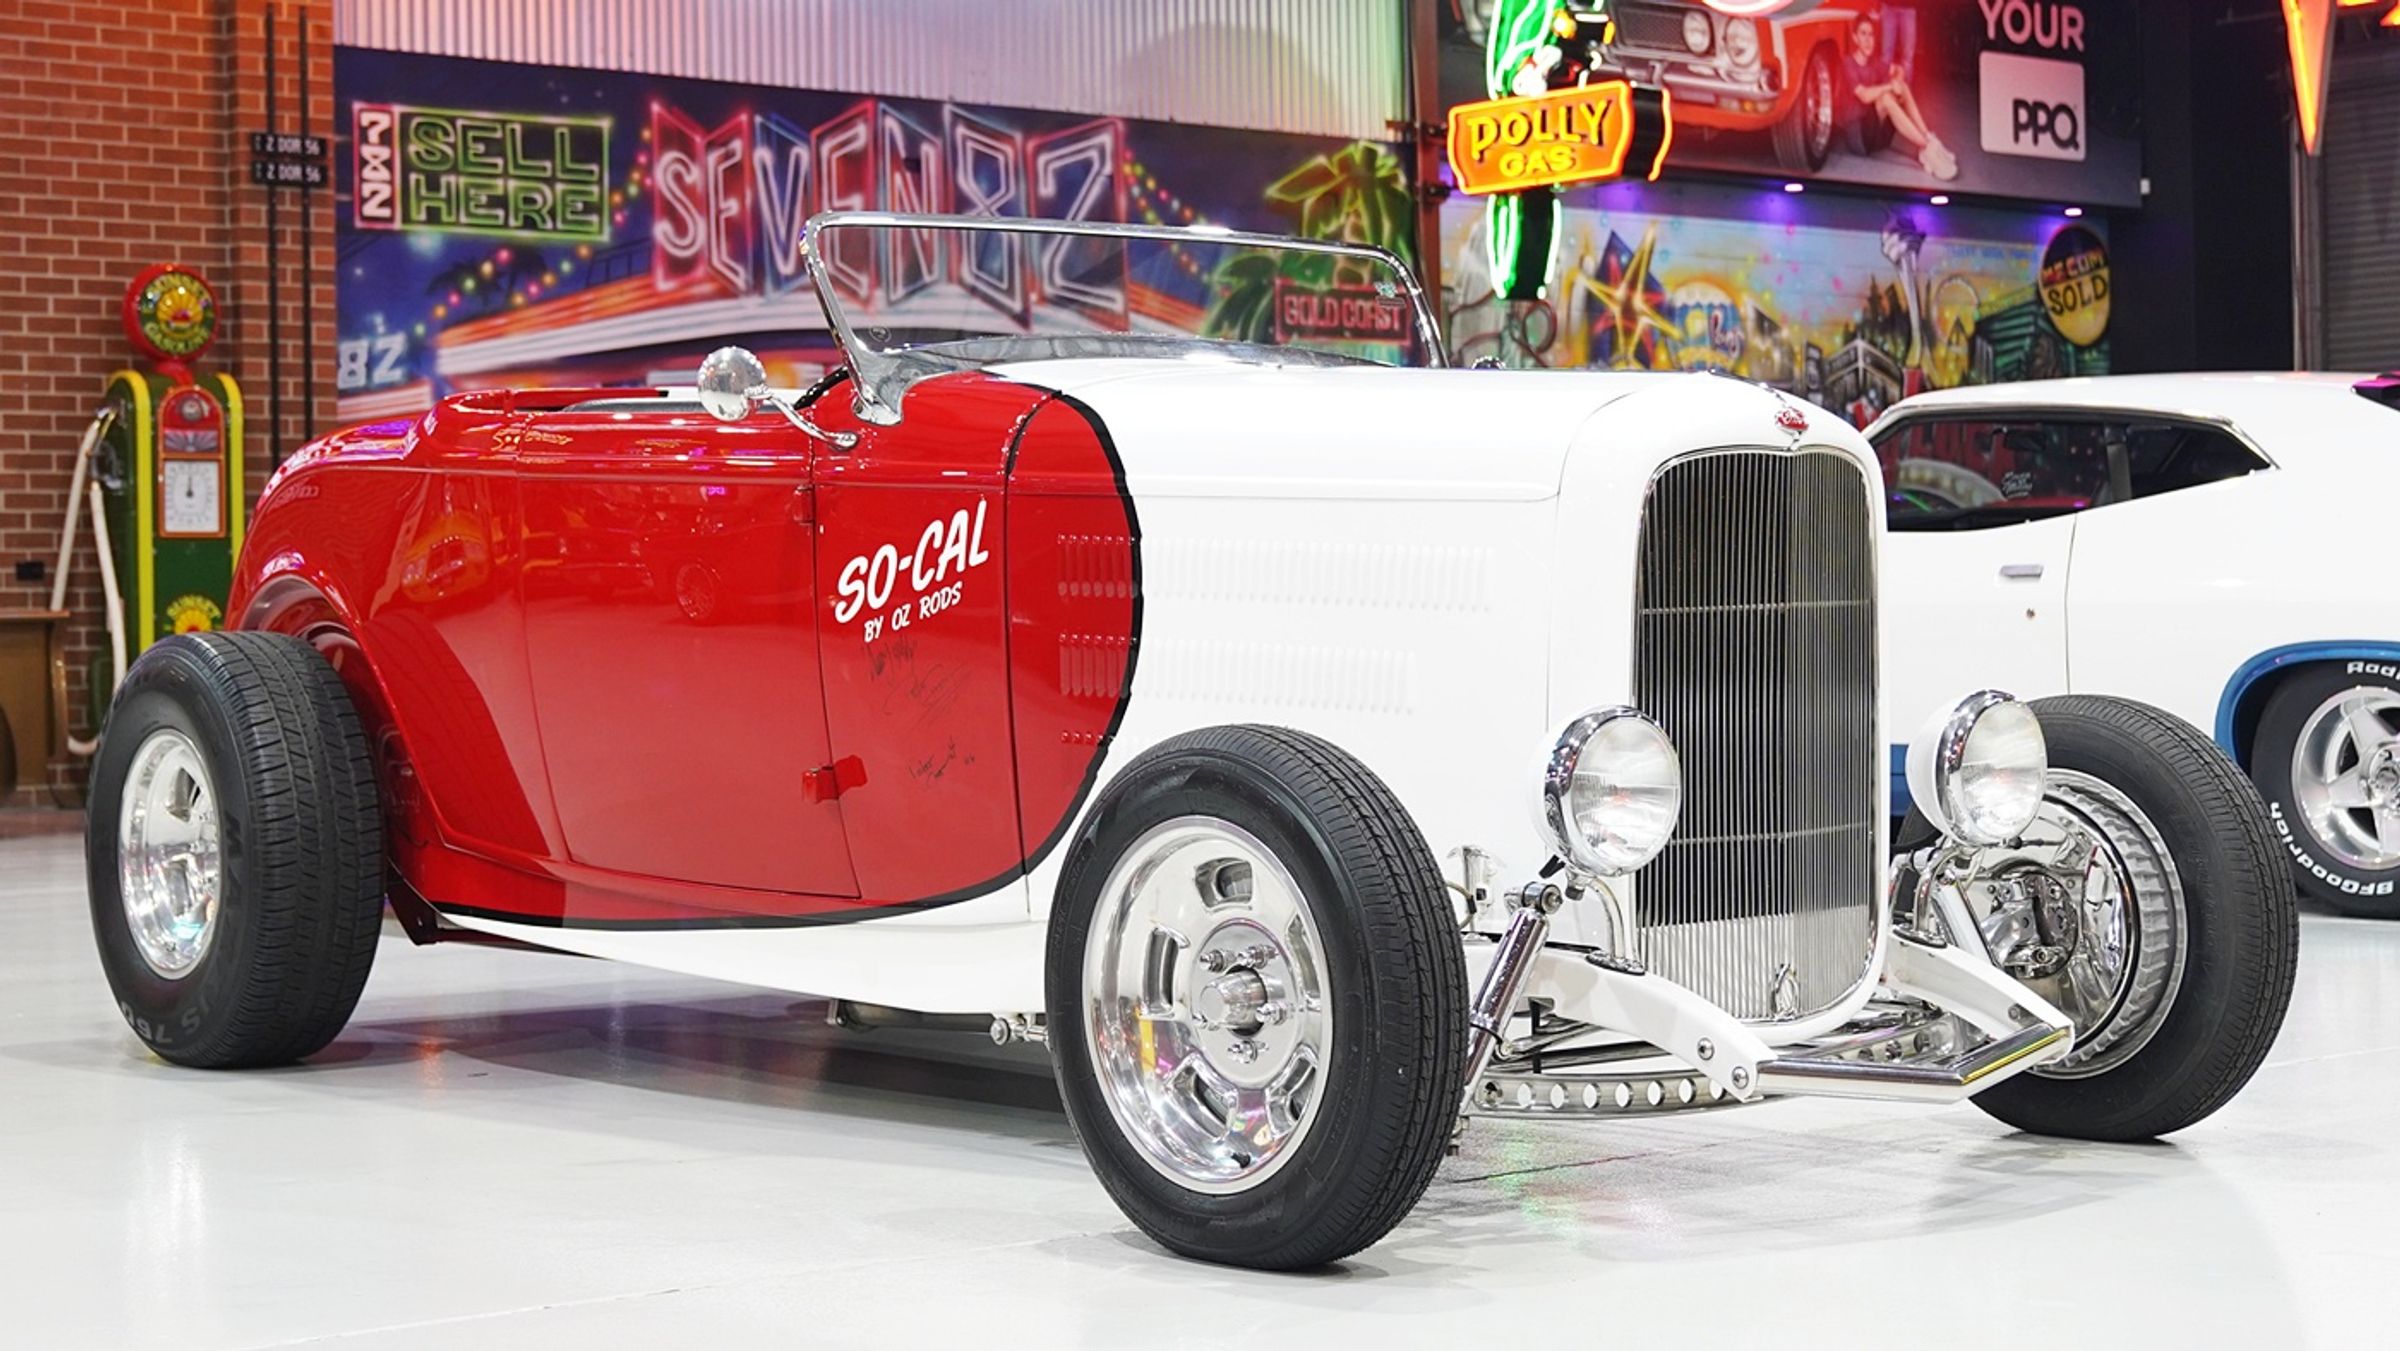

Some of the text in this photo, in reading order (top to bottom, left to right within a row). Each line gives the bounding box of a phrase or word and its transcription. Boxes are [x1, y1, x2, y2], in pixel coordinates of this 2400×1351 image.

[1978, 0, 2085, 51] YOUR
[408, 115, 600, 182] SELL
[1466, 99, 1612, 161] POLLY
[2013, 98, 2079, 151] PPQ
[1499, 145, 1577, 178] GAS
[408, 172, 600, 234] HERE
[1284, 294, 1400, 331] GOLD COAST
[2049, 273, 2108, 316] SOLD
[835, 499, 989, 624] SO-CAL
[864, 581, 963, 643] BY OZ RODS
[2270, 802, 2395, 896] BFGoodrich
[121, 1000, 173, 1044] 760
